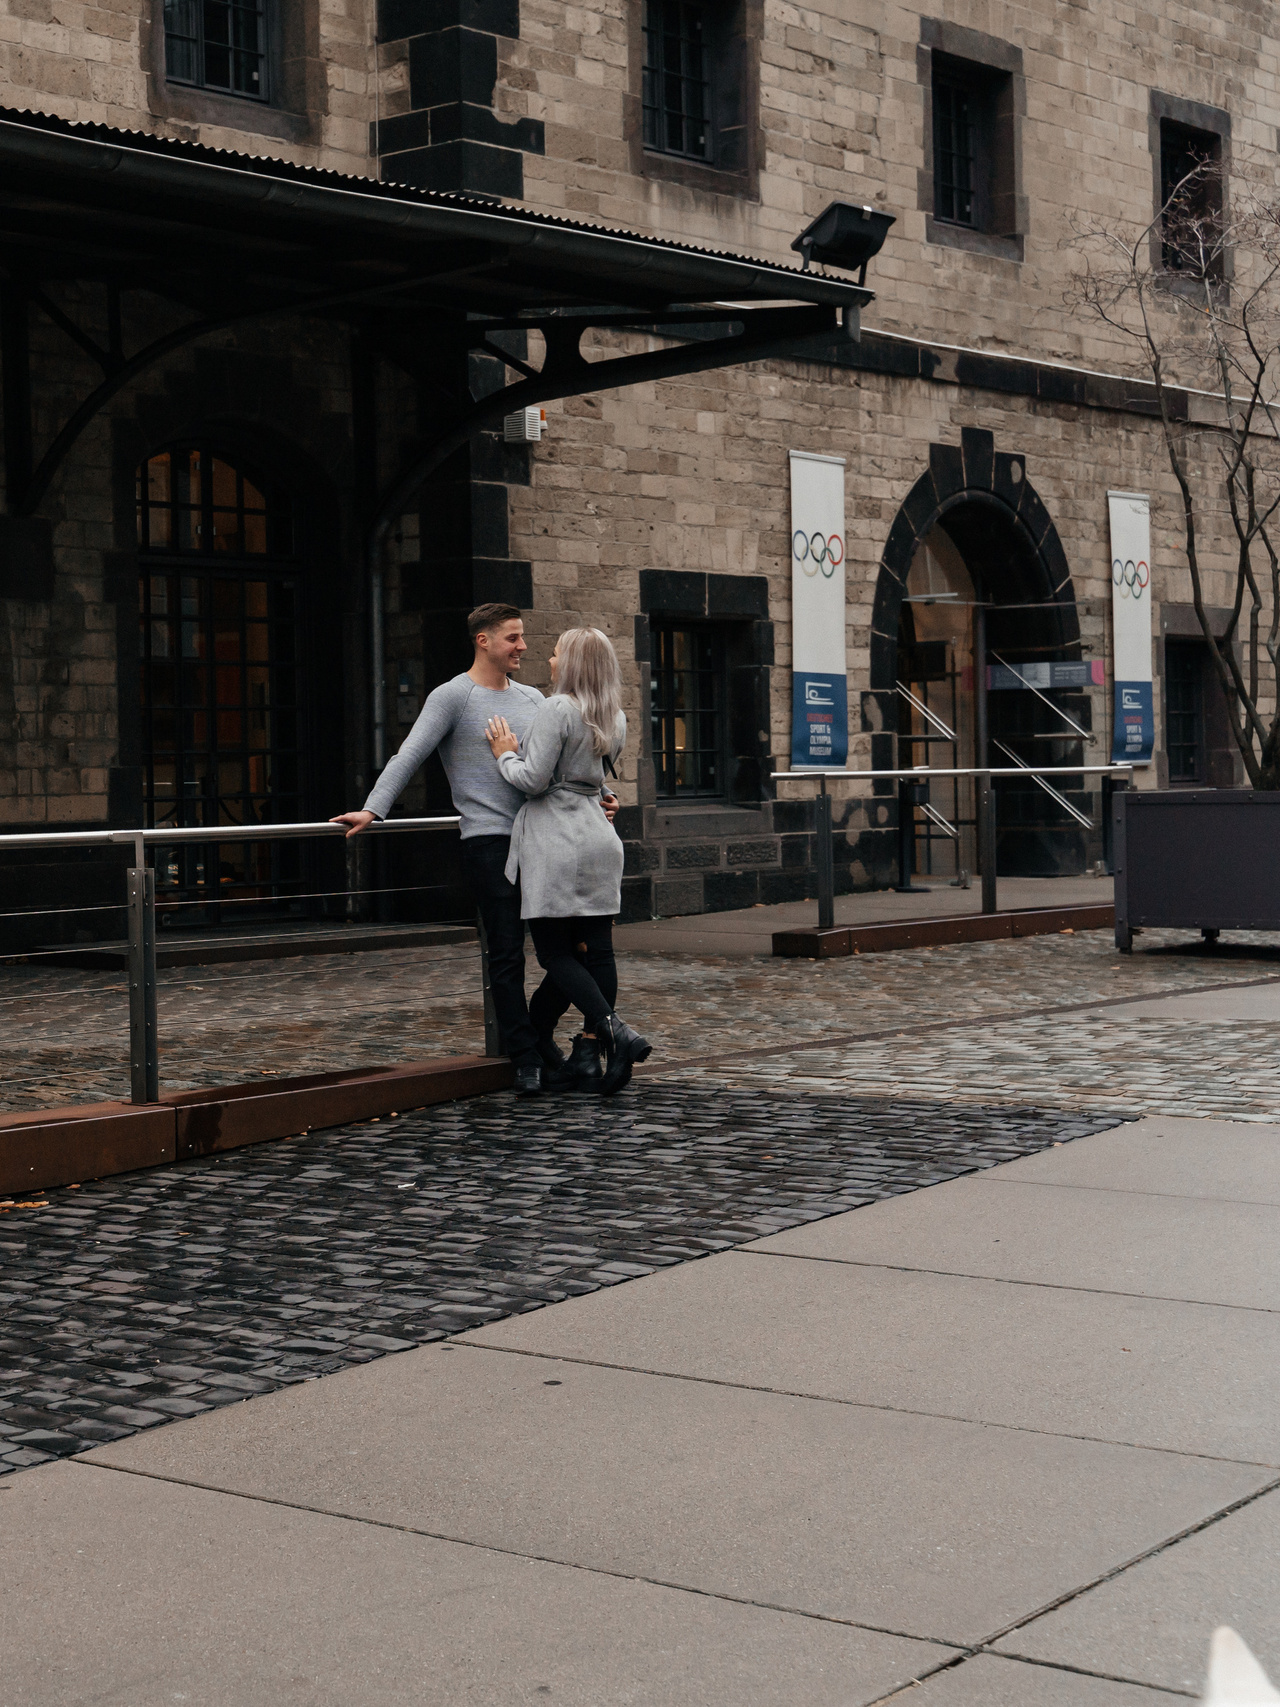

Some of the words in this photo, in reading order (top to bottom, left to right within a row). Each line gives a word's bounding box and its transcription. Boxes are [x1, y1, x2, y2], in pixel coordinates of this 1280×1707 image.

[810, 724, 826, 734] SPORT
[810, 735, 831, 744] OLYMPIA
[809, 746, 832, 755] MUSEUM
